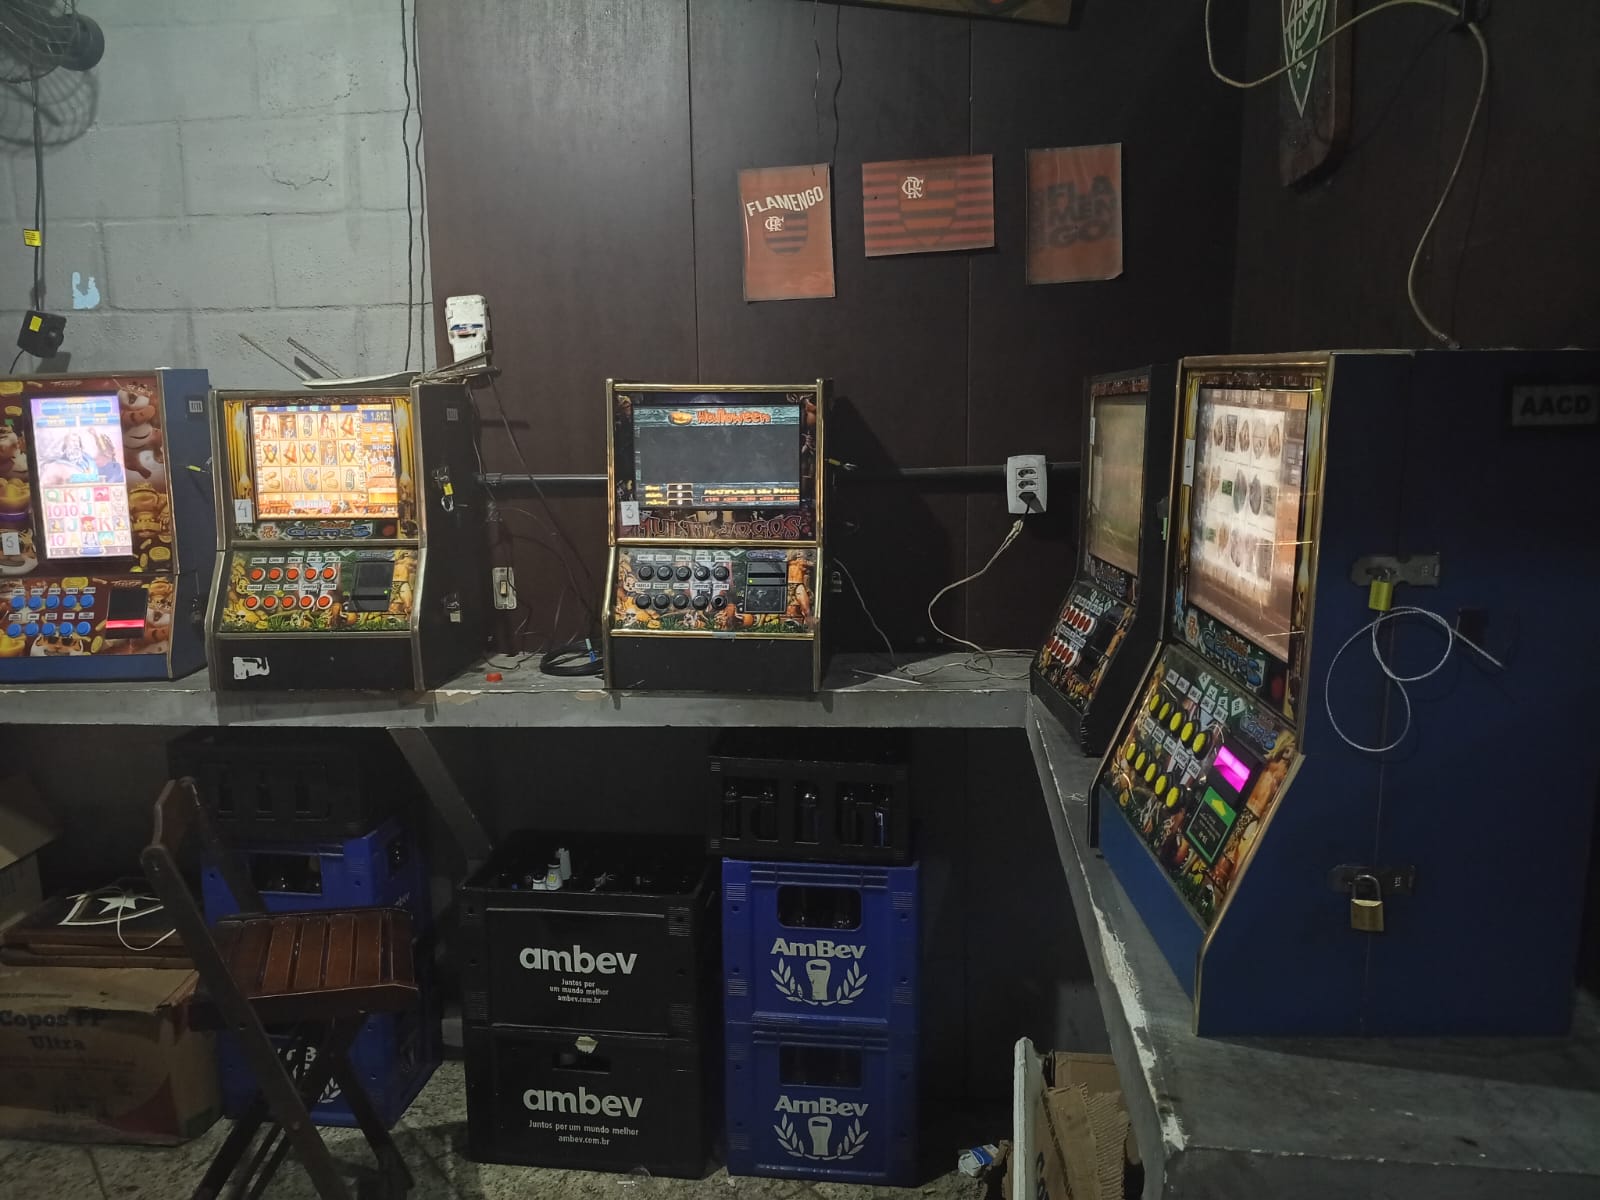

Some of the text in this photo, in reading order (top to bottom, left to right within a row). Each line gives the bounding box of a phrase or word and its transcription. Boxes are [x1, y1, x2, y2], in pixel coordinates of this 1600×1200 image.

[745, 186, 825, 217] FLAMENGO
[1521, 394, 1590, 416] AACD
[63, 489, 76, 502] K
[80, 488, 92, 501] J
[770, 937, 867, 959] AmBev
[519, 944, 638, 975] ambev
[549, 985, 609, 996] um mundo melhor
[562, 978, 596, 988] Juntos por
[558, 994, 602, 1004] ambev.com.br
[0, 1010, 69, 1031] Copos
[28, 1035, 86, 1050] Ultra
[523, 1086, 643, 1118] ambev
[774, 1095, 869, 1117] AmBev
[529, 1119, 553, 1129] Juntos
[555, 1122, 568, 1132] por
[584, 1124, 610, 1134] mundo
[612, 1126, 639, 1136] melhor
[558, 1135, 610, 1146] ambev.com.br
